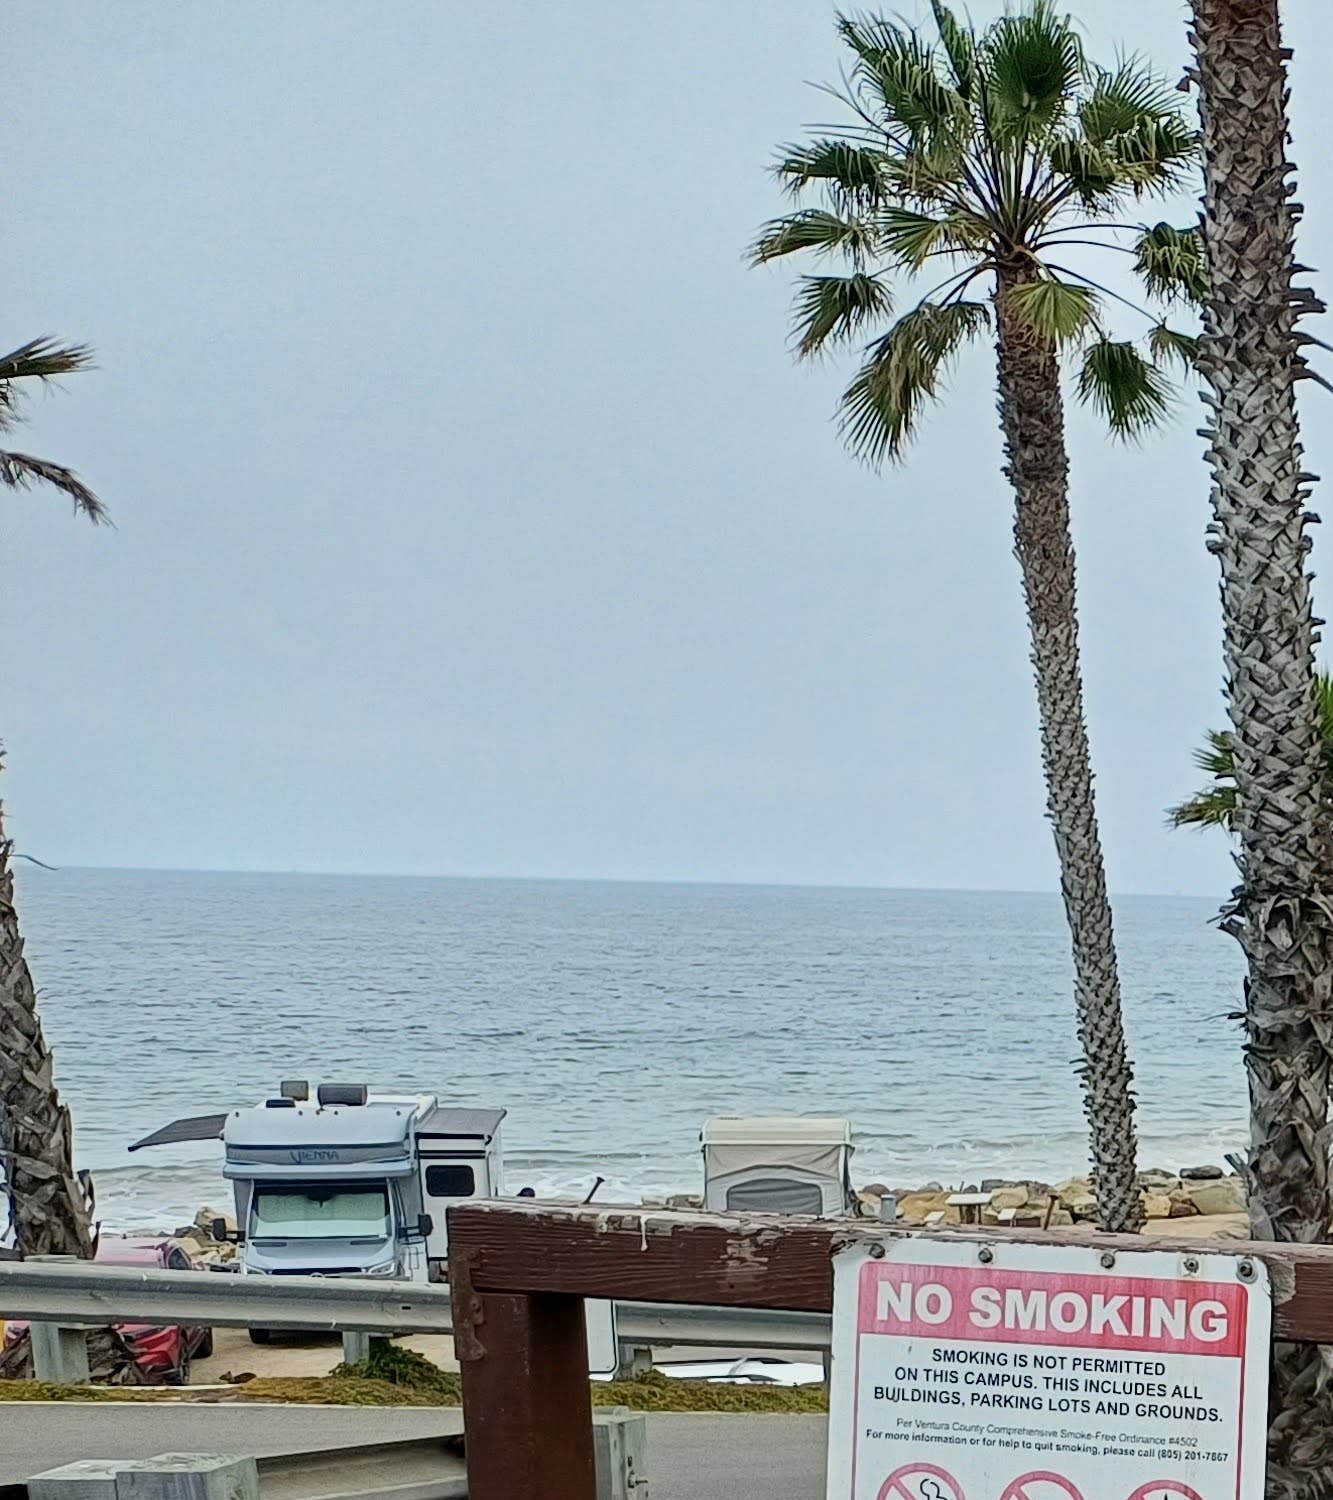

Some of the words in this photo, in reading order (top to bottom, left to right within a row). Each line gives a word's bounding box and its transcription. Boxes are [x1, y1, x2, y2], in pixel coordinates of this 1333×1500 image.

[875, 1280, 952, 1325] NO
[968, 1287, 1228, 1342] SMOKING
[932, 1349, 1008, 1366] SMOKING
[1013, 1354, 1028, 1368] IS
[1034, 1355, 1067, 1370] NOT
[1072, 1357, 1166, 1376] PERMITTED
[895, 1367, 918, 1381] ON
[923, 1369, 959, 1384] THIS
[964, 1372, 1038, 1389] CAMPUS.
[1043, 1377, 1079, 1391] THIS
[1084, 1379, 1167, 1397] INCLUDES
[1171, 1385, 1203, 1400] ALL
[874, 1386, 966, 1407] BUILDINGS,
[971, 1392, 1043, 1410] PARKING
[1049, 1398, 1091, 1413] LOTS
[1096, 1401, 1130, 1416] AND
[1135, 1403, 1223, 1422] GROUNDS.
[866, 1429, 882, 1439] For
[885, 1431, 909, 1441] more
[912, 1433, 967, 1446] information
[970, 1437, 980, 1445] or
[982, 1435, 1000, 1447] for
[999, 1438, 1019, 1450] help
[1022, 1440, 1032, 1449] to
[1034, 1440, 1053, 1452] quit
[1056, 1443, 1100, 1456] smoking,
[1103, 1446, 1135, 1458] please
[1137, 1448, 1155, 1458] call
[1157, 1449, 1182, 1461] (805)
[897, 1418, 912, 1428] Per
[915, 1419, 950, 1431] Ventura
[952, 1422, 985, 1435] County
[986, 1424, 1058, 1437] Comprehensive
[1060, 1429, 1117, 1442] Smoke-Free
[1119, 1433, 1166, 1446] Ordinance
[1168, 1437, 1198, 1448] #4502
